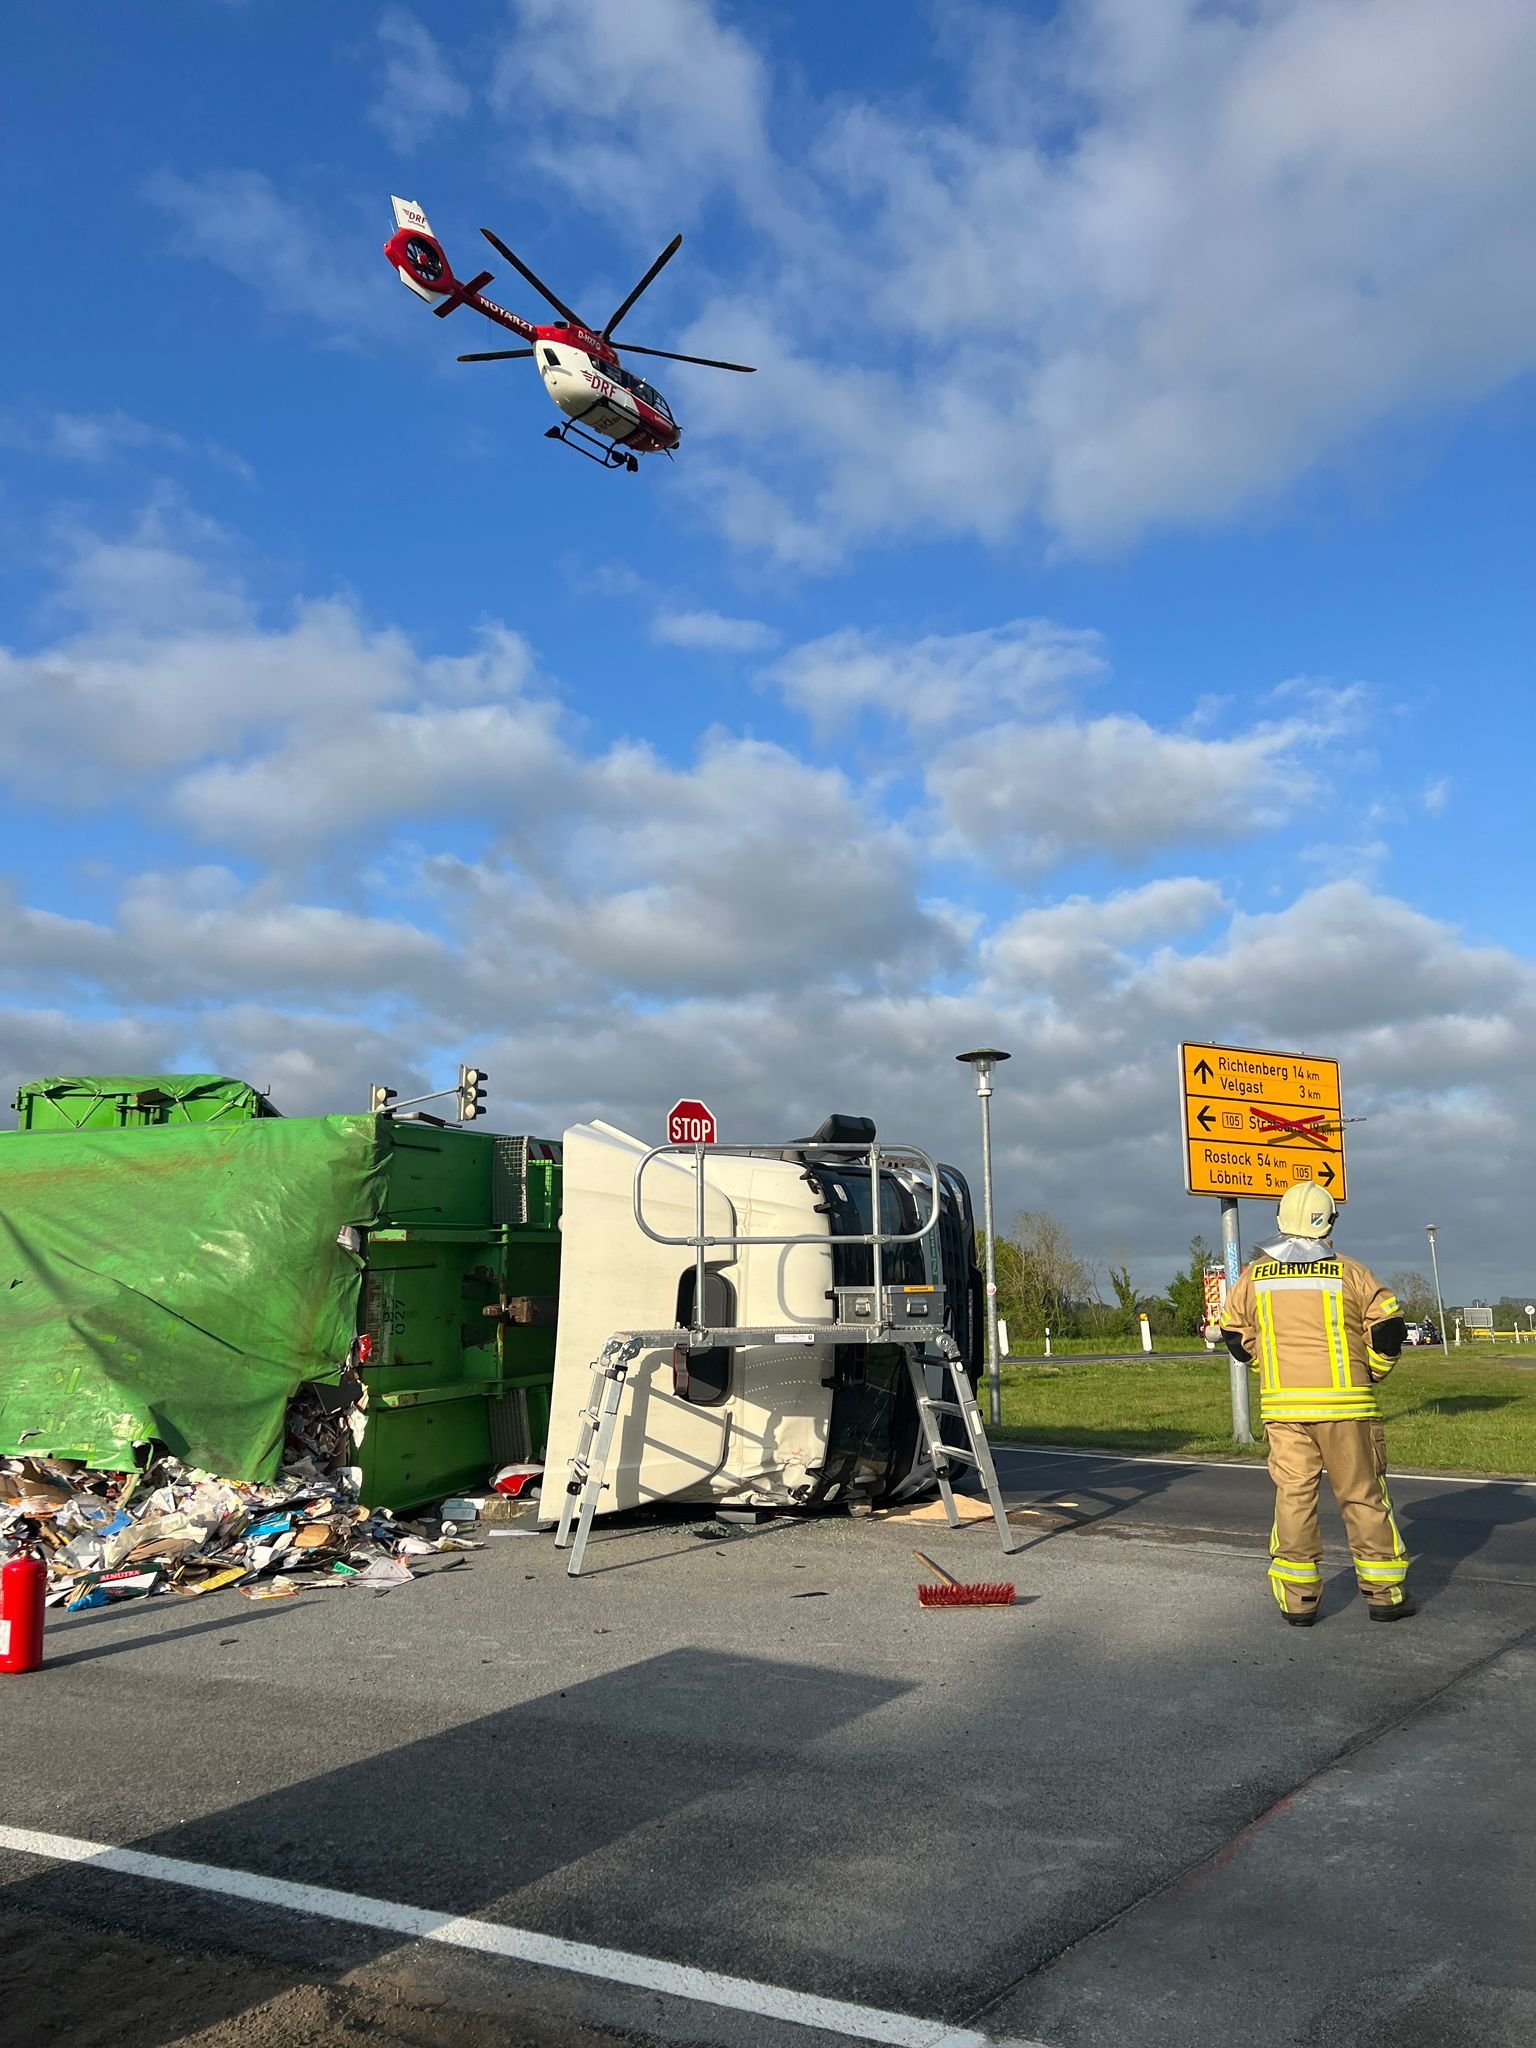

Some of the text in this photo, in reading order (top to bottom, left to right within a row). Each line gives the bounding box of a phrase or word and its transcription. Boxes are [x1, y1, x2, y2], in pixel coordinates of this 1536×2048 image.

[408, 211, 427, 224] DRF
[480, 297, 535, 333] NOTARZT
[591, 375, 617, 398] DRF
[1218, 1056, 1320, 1081] Richtenberg 14 km
[1219, 1077, 1321, 1100] Velgast 3 km
[672, 1116, 712, 1142] STOP
[1225, 1115, 1240, 1127] 105
[1321, 1125, 1335, 1137] km
[1204, 1149, 1287, 1168] Rostock 54 km
[1209, 1169, 1288, 1188] Löbnitz 5 km
[1295, 1167, 1310, 1179] 105
[1254, 1262, 1340, 1279] FEUERWEHR
